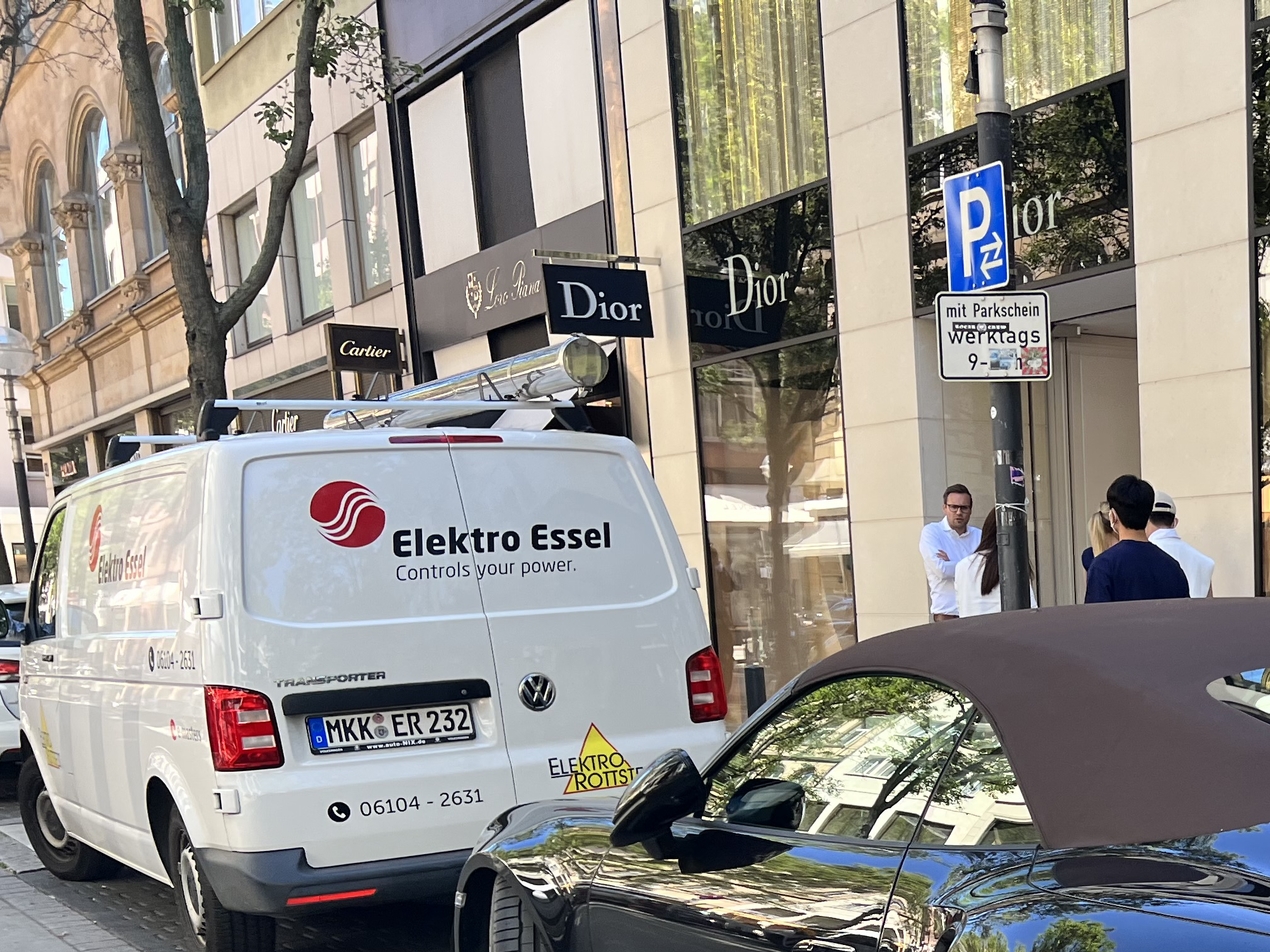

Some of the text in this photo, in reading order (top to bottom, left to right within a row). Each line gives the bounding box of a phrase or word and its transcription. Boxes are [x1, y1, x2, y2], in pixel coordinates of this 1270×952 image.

[959, 186, 992, 277] P
[1012, 189, 1062, 240] ior
[511, 260, 541, 300] Piana
[724, 253, 790, 318] Dior
[557, 281, 642, 322] Dior
[946, 302, 1040, 318] mit Parkschein
[339, 339, 392, 361] Cartier
[948, 329, 1041, 348] werktags
[393, 522, 611, 558] Elektro Essel
[98, 546, 147, 584] Elektro Essel
[396, 559, 577, 582] Controls your power.
[157, 650, 175, 670] 06104
[180, 650, 196, 670] 2631
[273, 671, 386, 688] TRANSPORTER
[316, 708, 470, 744] D MKK ER 232
[360, 798, 421, 817] 06104
[440, 788, 484, 808] 2631
